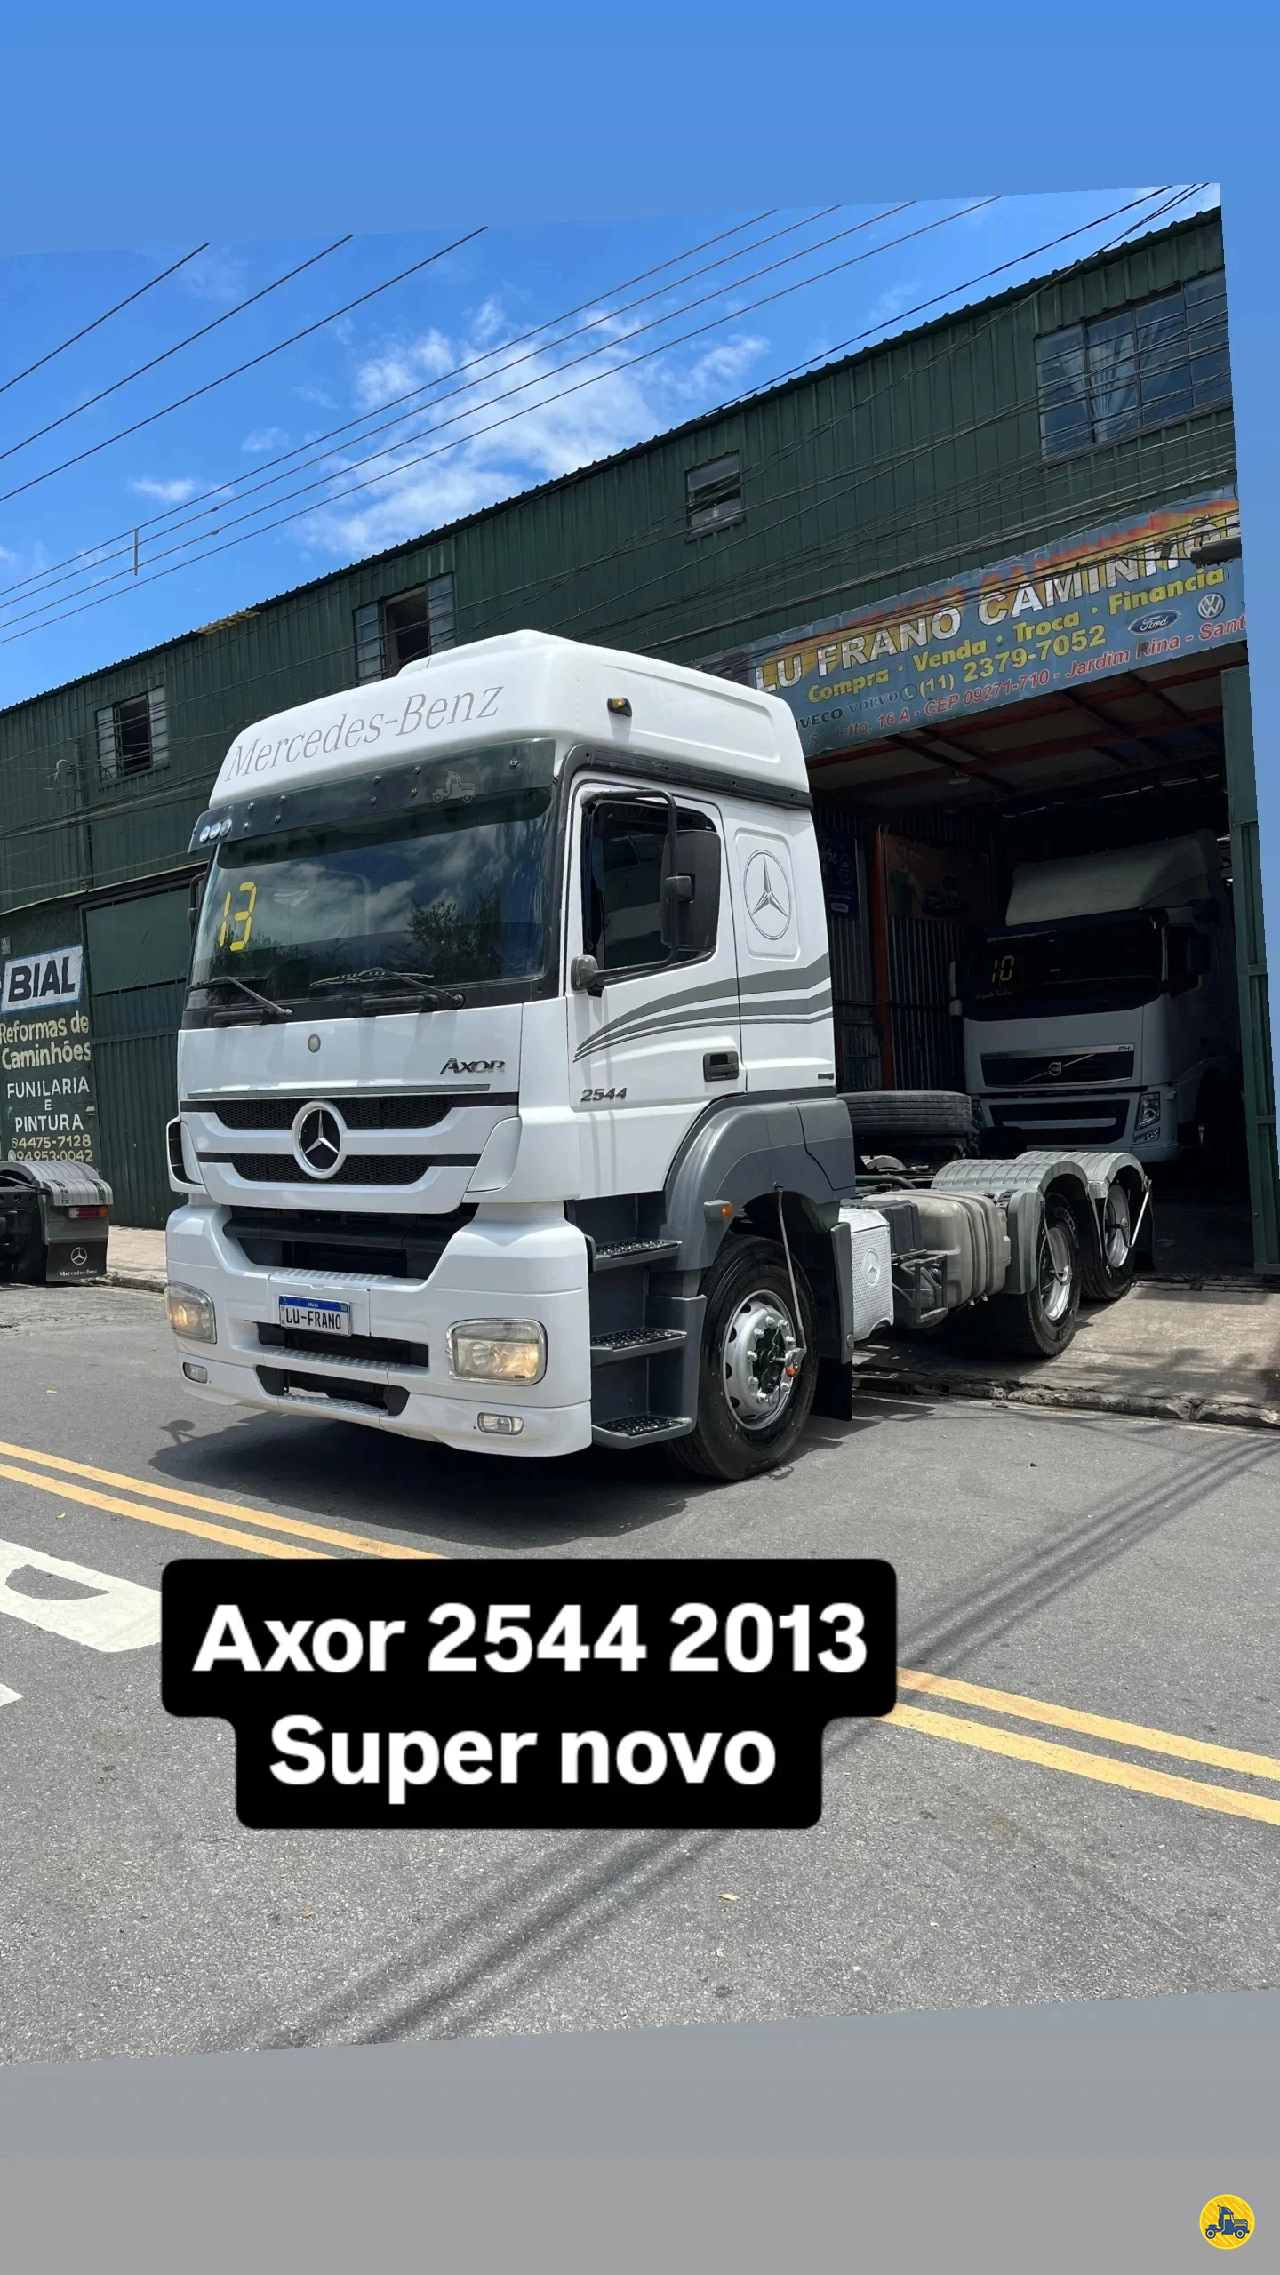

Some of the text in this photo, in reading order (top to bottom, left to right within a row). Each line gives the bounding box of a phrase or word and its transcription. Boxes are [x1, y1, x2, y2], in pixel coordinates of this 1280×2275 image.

[755, 654, 802, 692] LU
[818, 607, 962, 677] FRANO
[807, 567, 1225, 703] Compra Venda Troca Financia
[848, 691, 899, 714] VOLVO
[919, 673, 956, 699] (11)
[962, 625, 1107, 683] 2379-7052
[878, 713, 895, 729] 16
[899, 708, 910, 724] A
[924, 693, 960, 717] CEP
[963, 669, 1050, 706] 09271-710
[1065, 648, 1131, 680] Jardim
[1135, 635, 1181, 660] Rina
[224, 685, 505, 783] Mercedes-Benz
[219, 881, 257, 953] 13
[8, 956, 76, 1003] BIAL
[991, 953, 1015, 985] 10
[0, 1010, 90, 1044] Reformas de
[2, 1040, 92, 1071] Caminhões
[7, 1076, 91, 1099] FUNILARIA
[580, 1087, 628, 1102] 2544
[44, 1099, 53, 1111] E
[15, 1113, 85, 1133] PINTURA
[19, 1134, 92, 1149] 4475-7128
[285, 1307, 342, 1330] LU-FRANO
